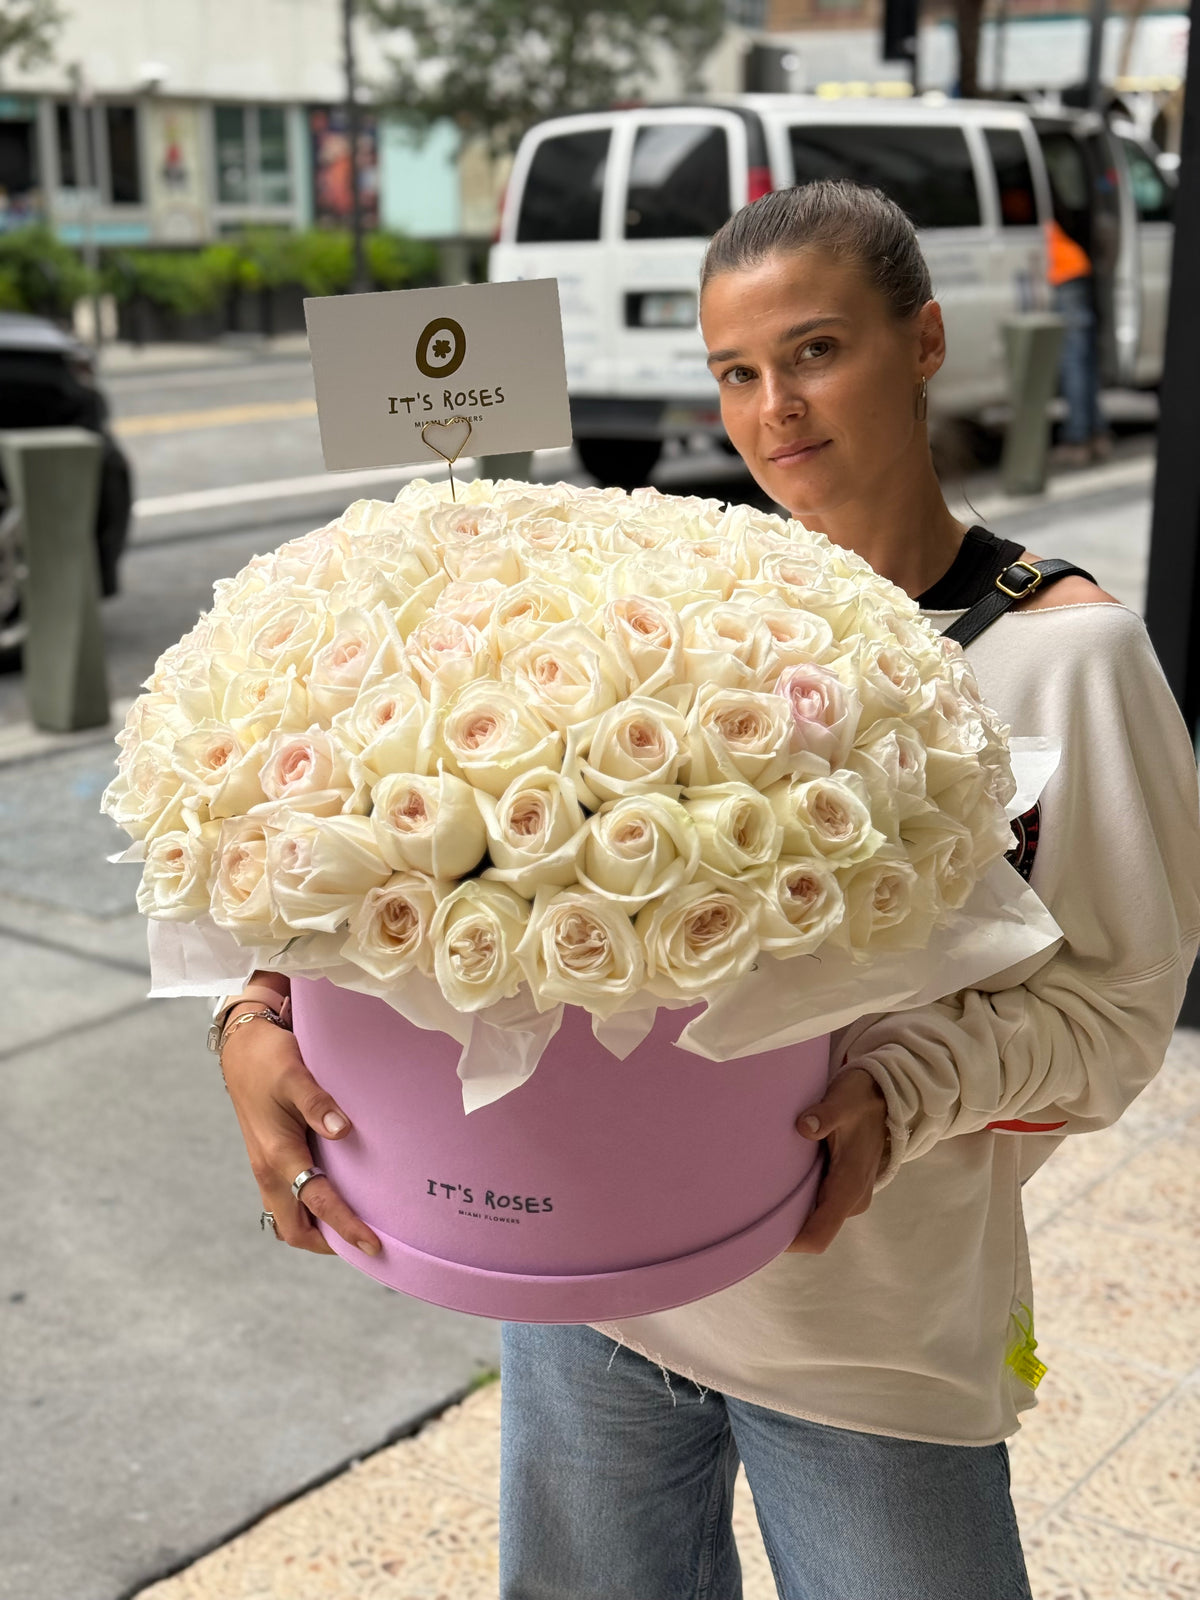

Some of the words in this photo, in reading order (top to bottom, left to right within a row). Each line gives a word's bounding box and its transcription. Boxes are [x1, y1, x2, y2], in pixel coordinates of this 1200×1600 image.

[388, 392, 434, 414] IT'S
[443, 387, 505, 410] ROSES
[444, 415, 484, 426] FOWERS
[427, 1179, 474, 1203] IT'S
[485, 1190, 553, 1213] ROSES
[458, 1209, 482, 1219] MIAMI
[484, 1214, 521, 1224] FLOWERS
